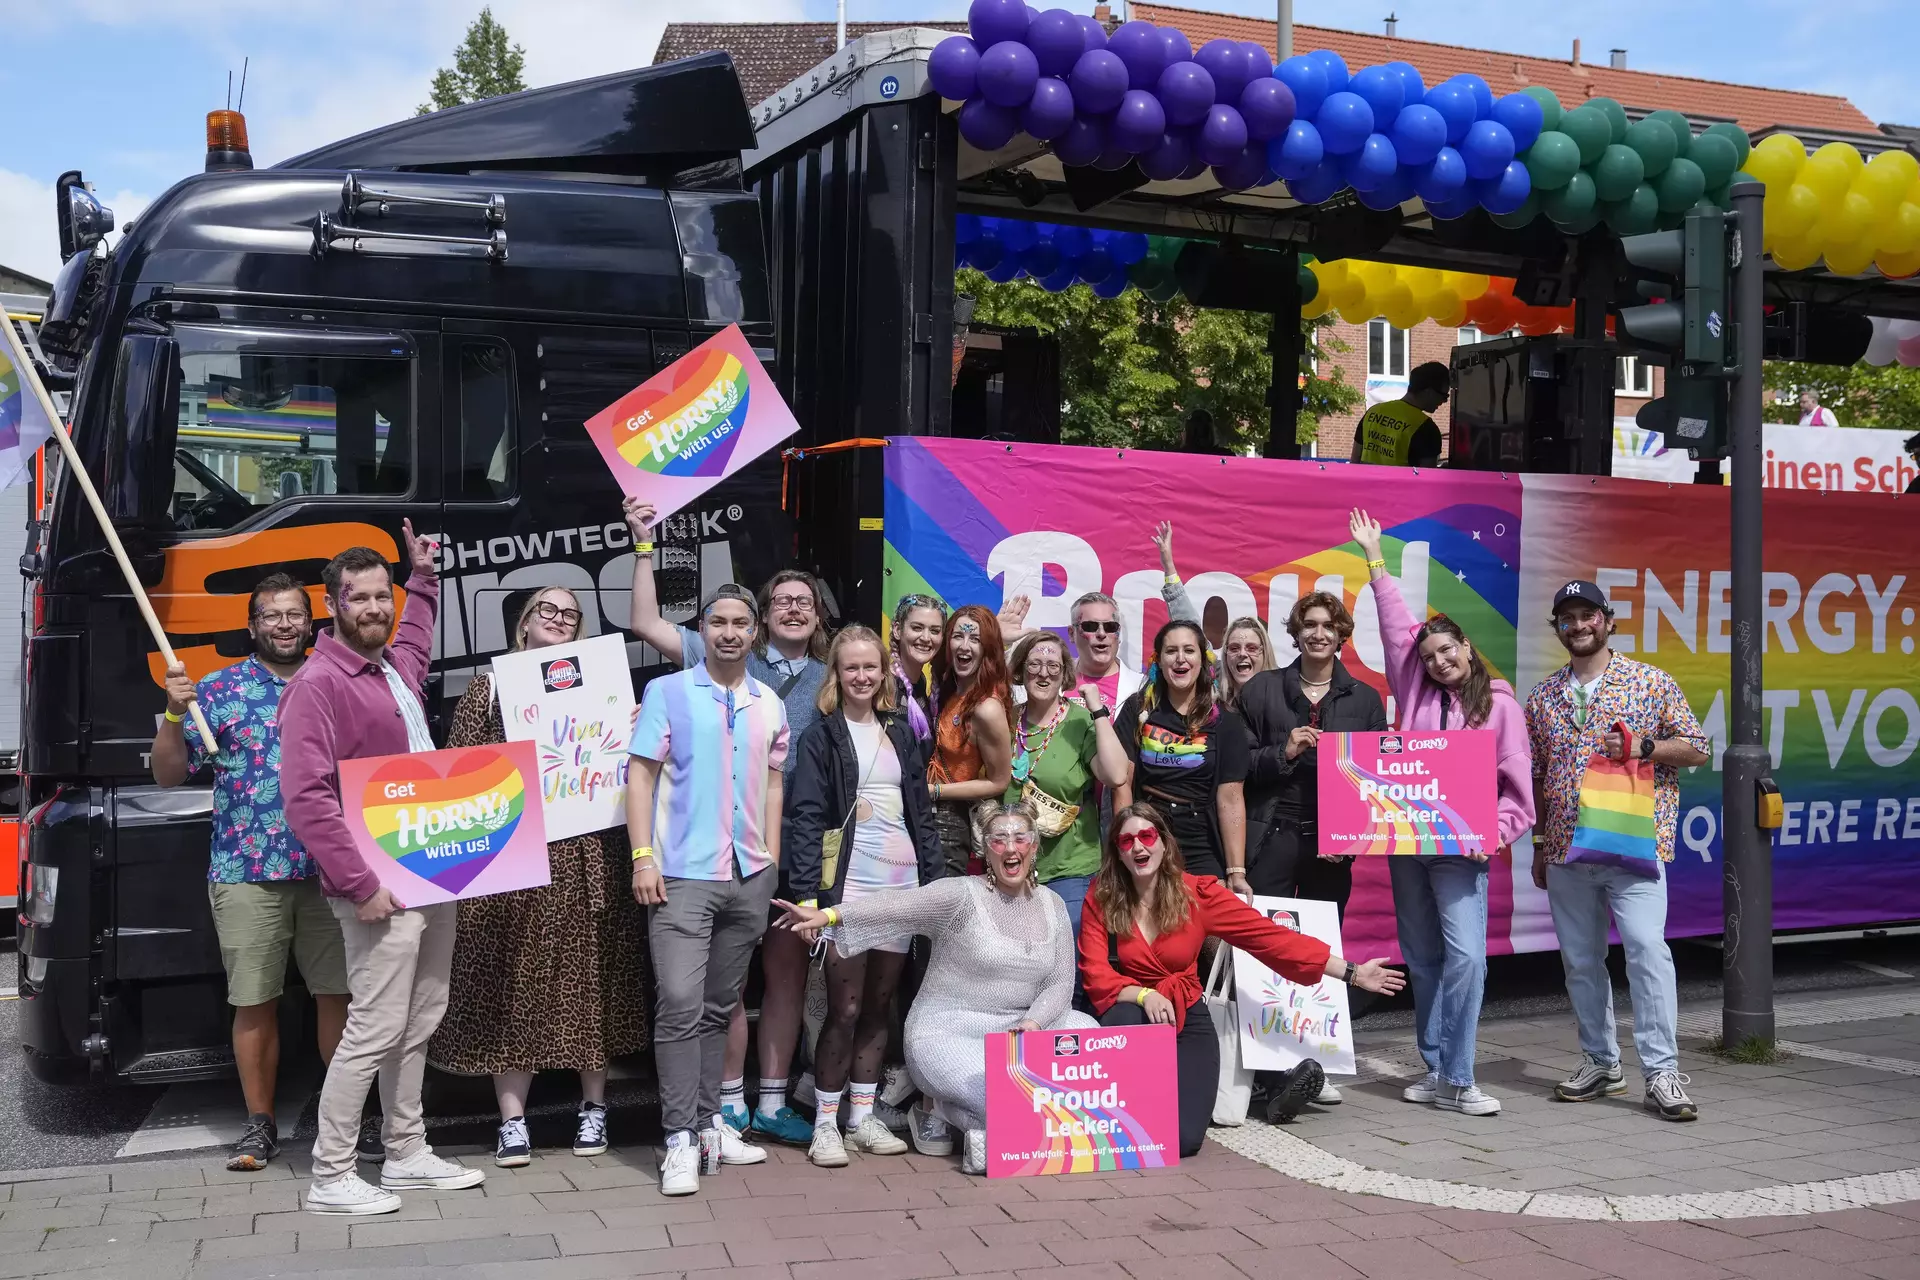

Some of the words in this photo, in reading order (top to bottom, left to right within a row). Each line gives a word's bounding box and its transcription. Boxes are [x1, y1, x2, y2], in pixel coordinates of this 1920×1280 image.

[626, 408, 654, 432] Get
[645, 380, 728, 462] HORNY
[1368, 412, 1411, 432] ENERGY
[679, 434, 712, 461] with
[711, 418, 734, 439] us!
[1368, 430, 1395, 446] WAGEN
[1762, 449, 1843, 491] inen
[1854, 456, 1920, 494] Sch
[1596, 567, 1915, 654] ENERGY:
[546, 673, 580, 685] SCHWARTAU
[553, 715, 603, 748] Viva
[1408, 737, 1444, 751] CORNY
[574, 745, 591, 766] la
[1155, 751, 1182, 765] Love
[1377, 758, 1430, 775] Laut.
[384, 782, 416, 799] Get
[1359, 778, 1447, 801] Proud.
[396, 792, 499, 848] HORNY
[1371, 806, 1443, 823] Lecker.
[1331, 833, 1348, 841] Viva
[1349, 833, 1357, 841] la
[1358, 833, 1387, 842] Vielfalt
[1414, 833, 1428, 842] auf
[1447, 833, 1457, 841] du
[1458, 833, 1486, 841] stehst.
[1683, 799, 1861, 862] QERE
[425, 841, 463, 859] with
[466, 836, 490, 853] us!
[1289, 989, 1305, 1008] la
[1261, 1007, 1339, 1043] Vielfalt
[1085, 1035, 1124, 1052] CORNY
[1051, 1061, 1109, 1081] Laut.
[1033, 1082, 1126, 1112] Proud.
[1045, 1116, 1122, 1138] Lecker.
[1001, 1152, 1020, 1161] Viva
[1021, 1151, 1030, 1160] la
[1032, 1149, 1063, 1159] Vielfalt
[1092, 1146, 1107, 1156] auf
[1108, 1145, 1124, 1154] was
[1126, 1144, 1136, 1153] du
[1138, 1142, 1166, 1152] stehst.
